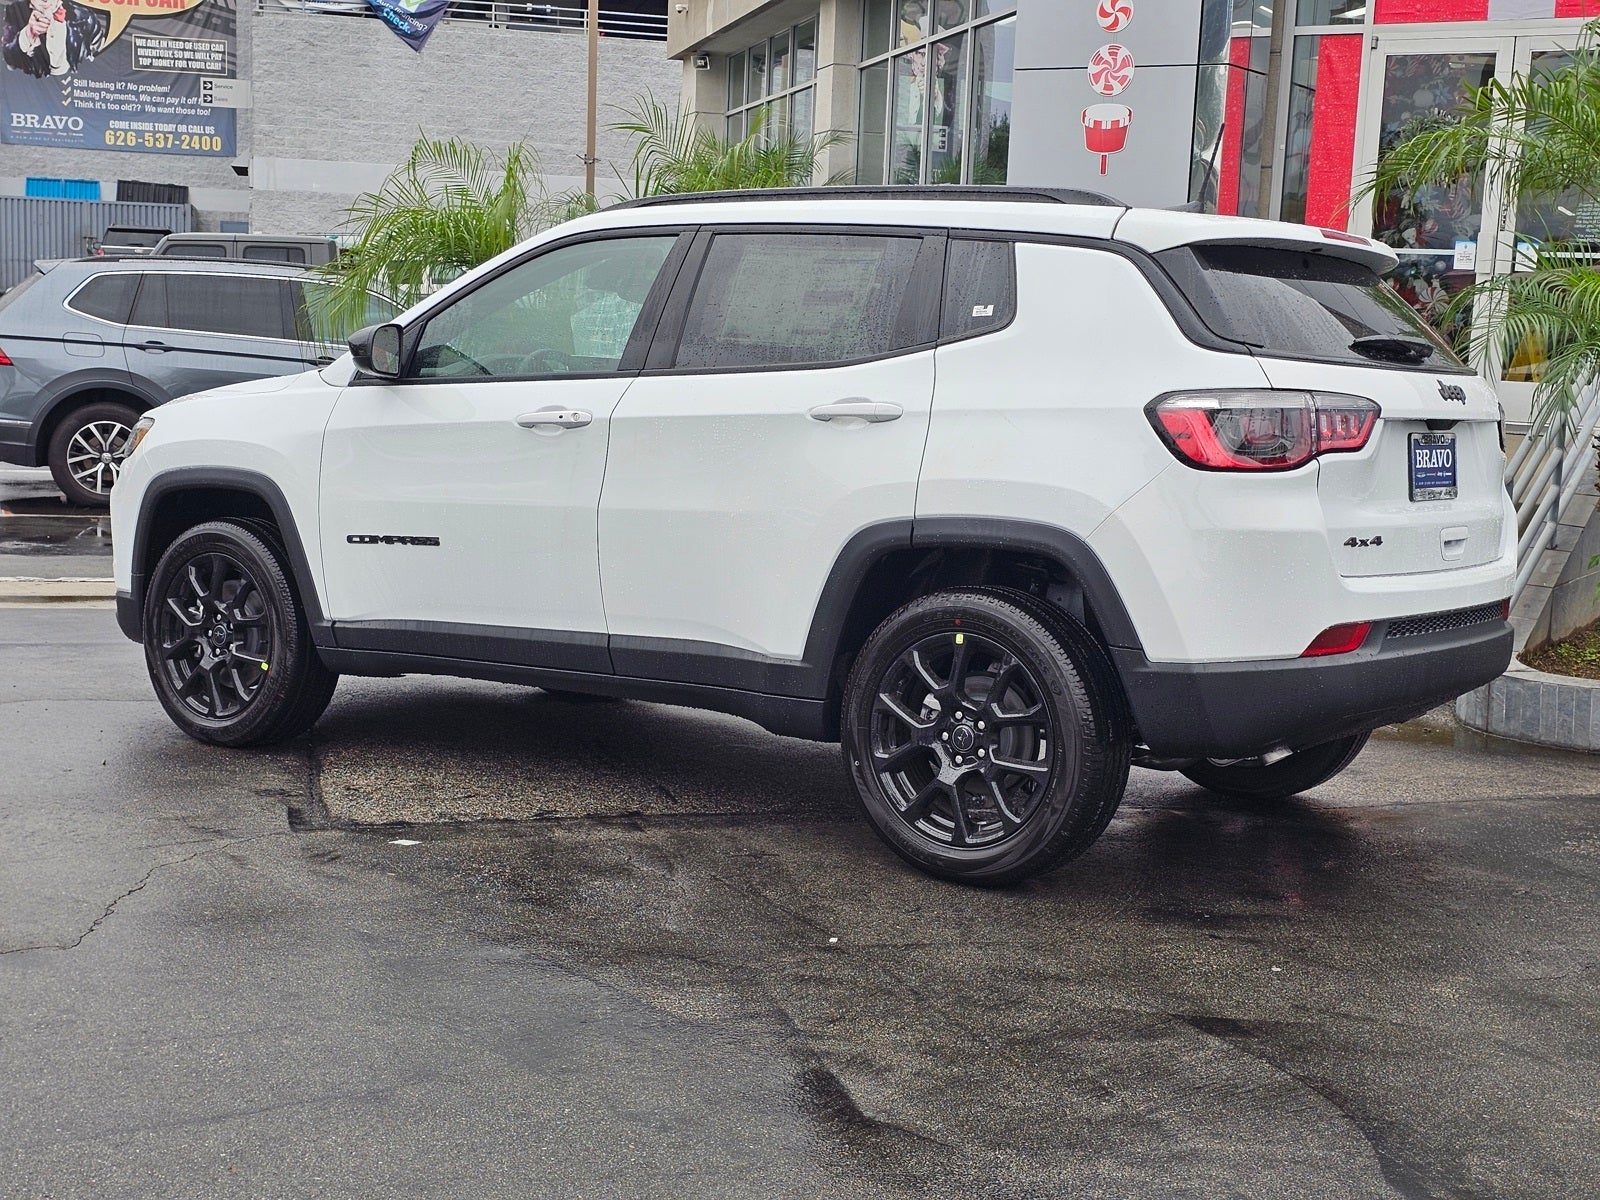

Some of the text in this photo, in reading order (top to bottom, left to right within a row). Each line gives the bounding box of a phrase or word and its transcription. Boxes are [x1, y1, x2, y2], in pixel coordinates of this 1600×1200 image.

[383, 7, 411, 34] Check.
[135, 38, 224, 52] WE ARE IN NEED OF USED CAR
[137, 48, 223, 61] INVENTORY, SO WE WILL PAY
[139, 57, 222, 70] TOP MONEY FOR YOUR CAR!
[73, 78, 171, 93] Still leasing it? No problem!
[214, 82, 233, 90] Service
[73, 89, 100, 100] Making
[100, 91, 138, 102] Payments,
[139, 94, 151, 102] We
[166, 97, 180, 105] pay
[180, 95, 186, 104] it
[187, 96, 198, 105] off
[73, 99, 94, 109] Think
[95, 101, 106, 109] it's
[120, 103, 141, 111] old??
[175, 106, 196, 115] those
[196, 108, 211, 116] too!
[10, 113, 84, 131] BRAVO
[109, 120, 215, 135] COME INSIDE TODAY OR CALL US
[105, 130, 222, 152] 626-537-2400
[1436, 379, 1467, 406] Jeep
[1415, 448, 1452, 469] BRAVO
[346, 534, 441, 547] COMPASS
[1343, 535, 1384, 548] 4x4
